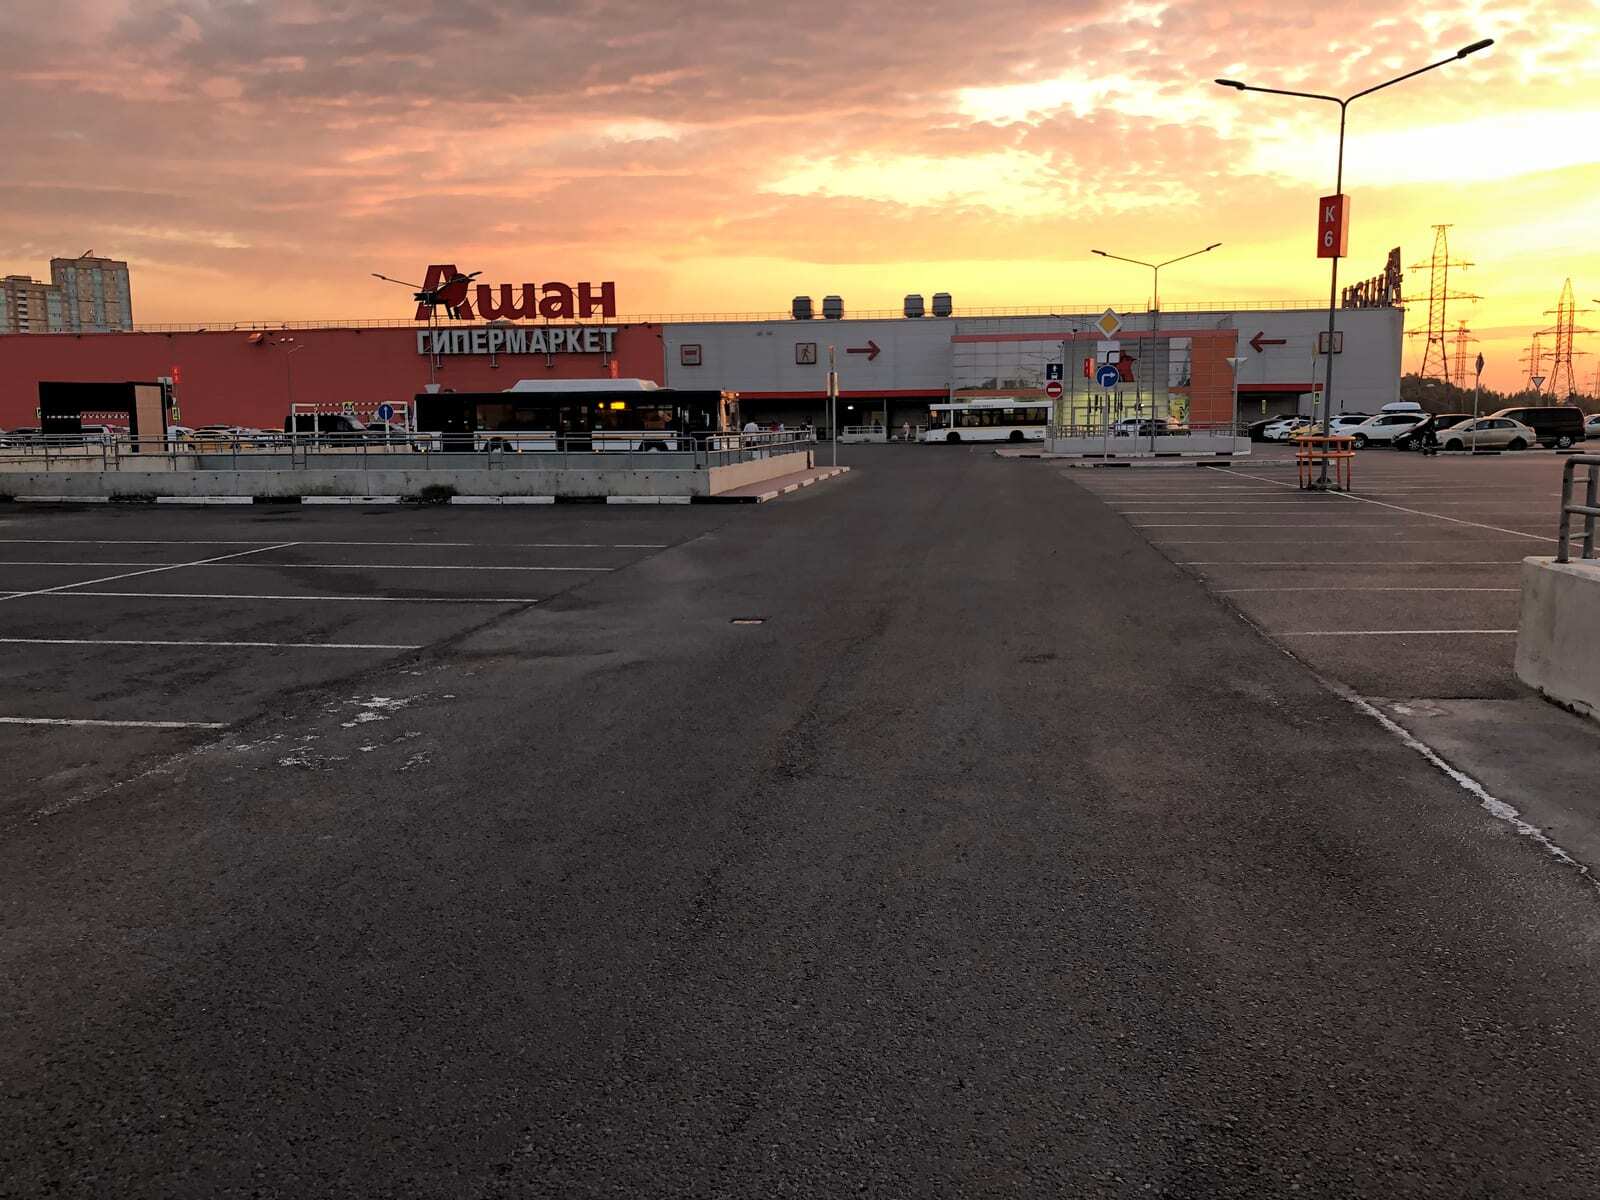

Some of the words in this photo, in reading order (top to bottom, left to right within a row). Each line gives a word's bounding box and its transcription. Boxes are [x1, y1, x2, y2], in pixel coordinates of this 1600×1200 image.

[1324, 230, 1333, 247] 6
[415, 264, 616, 320] Ашан
[416, 328, 618, 354] ГИПЕРМАРКЕТ
